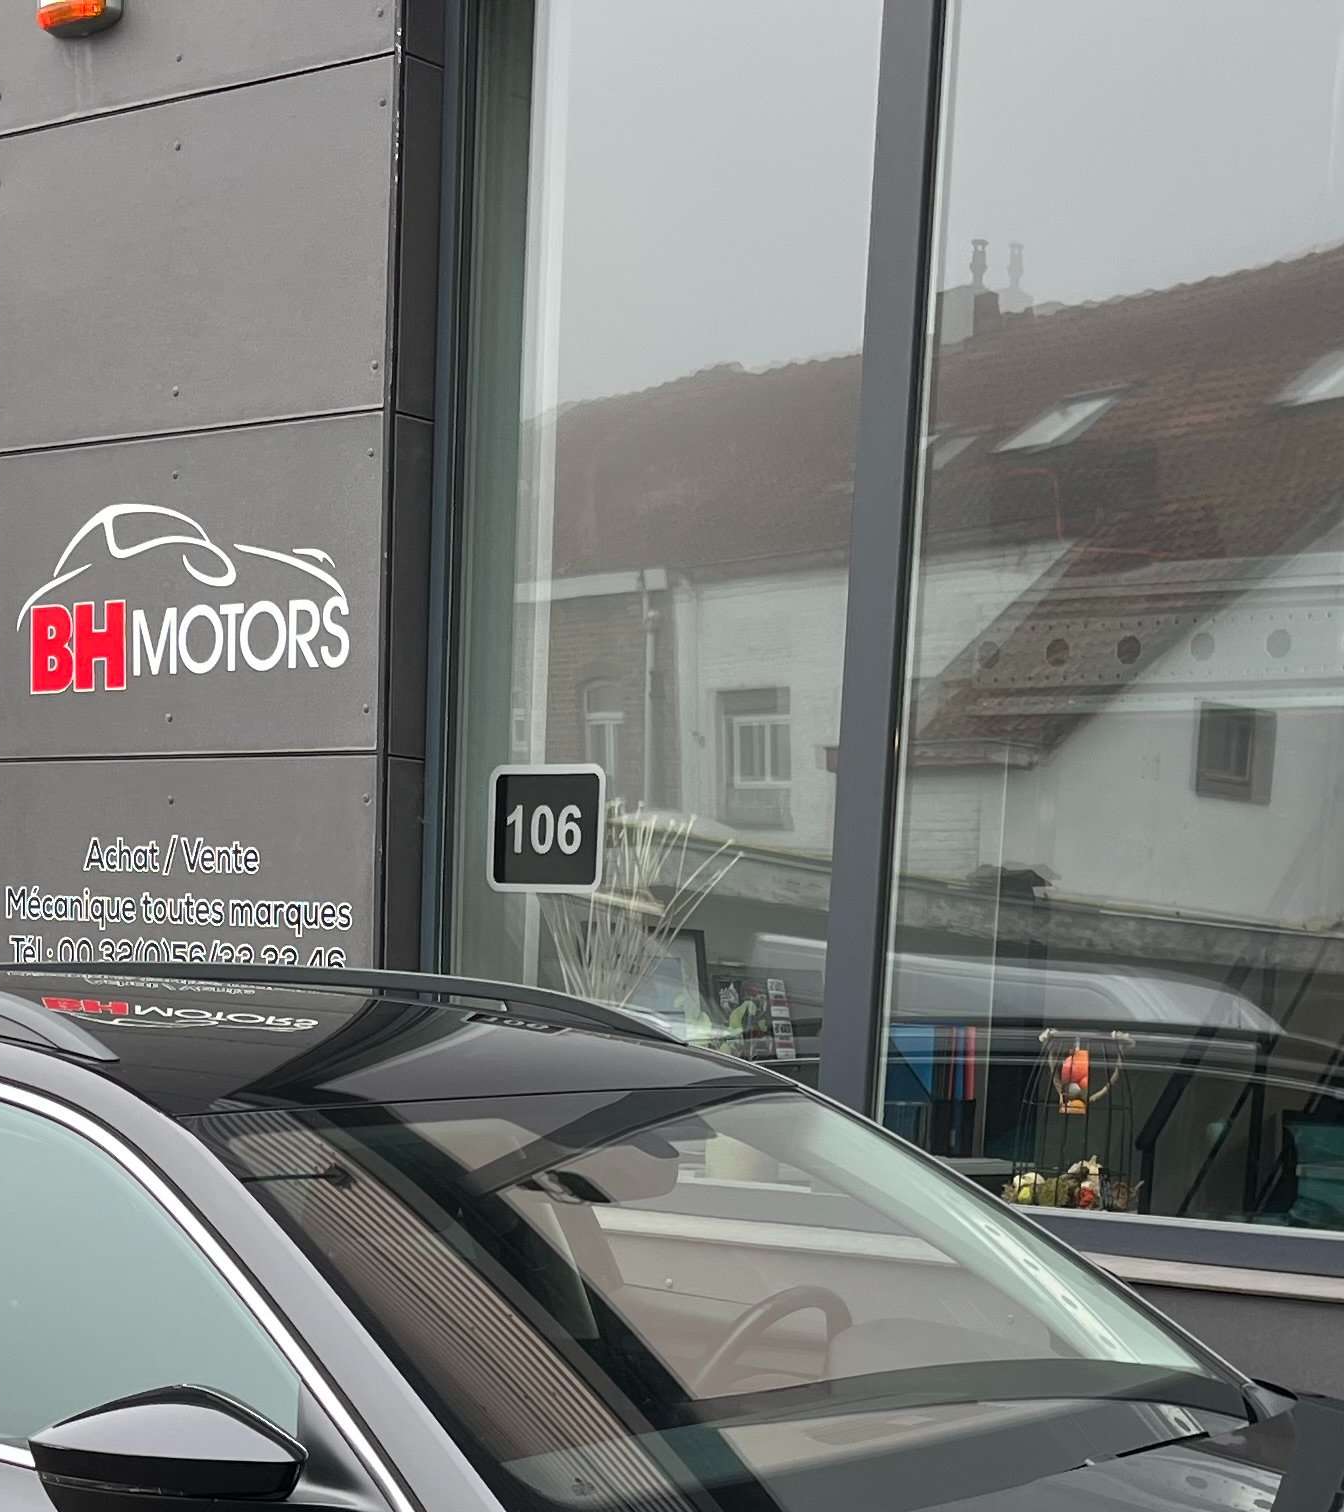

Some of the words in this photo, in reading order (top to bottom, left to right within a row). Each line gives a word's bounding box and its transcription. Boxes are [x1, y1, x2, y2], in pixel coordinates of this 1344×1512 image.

[30, 600, 126, 695] BH
[132, 596, 350, 676] MOTORS
[83, 836, 159, 873] Achat
[161, 834, 179, 876] /
[180, 836, 260, 875] Vente
[505, 804, 582, 855] 106
[5, 886, 137, 930] Mécanique
[139, 892, 225, 927] toutes
[228, 898, 353, 938] marques
[9, 935, 33, 963] Tél
[57, 936, 94, 963] 00
